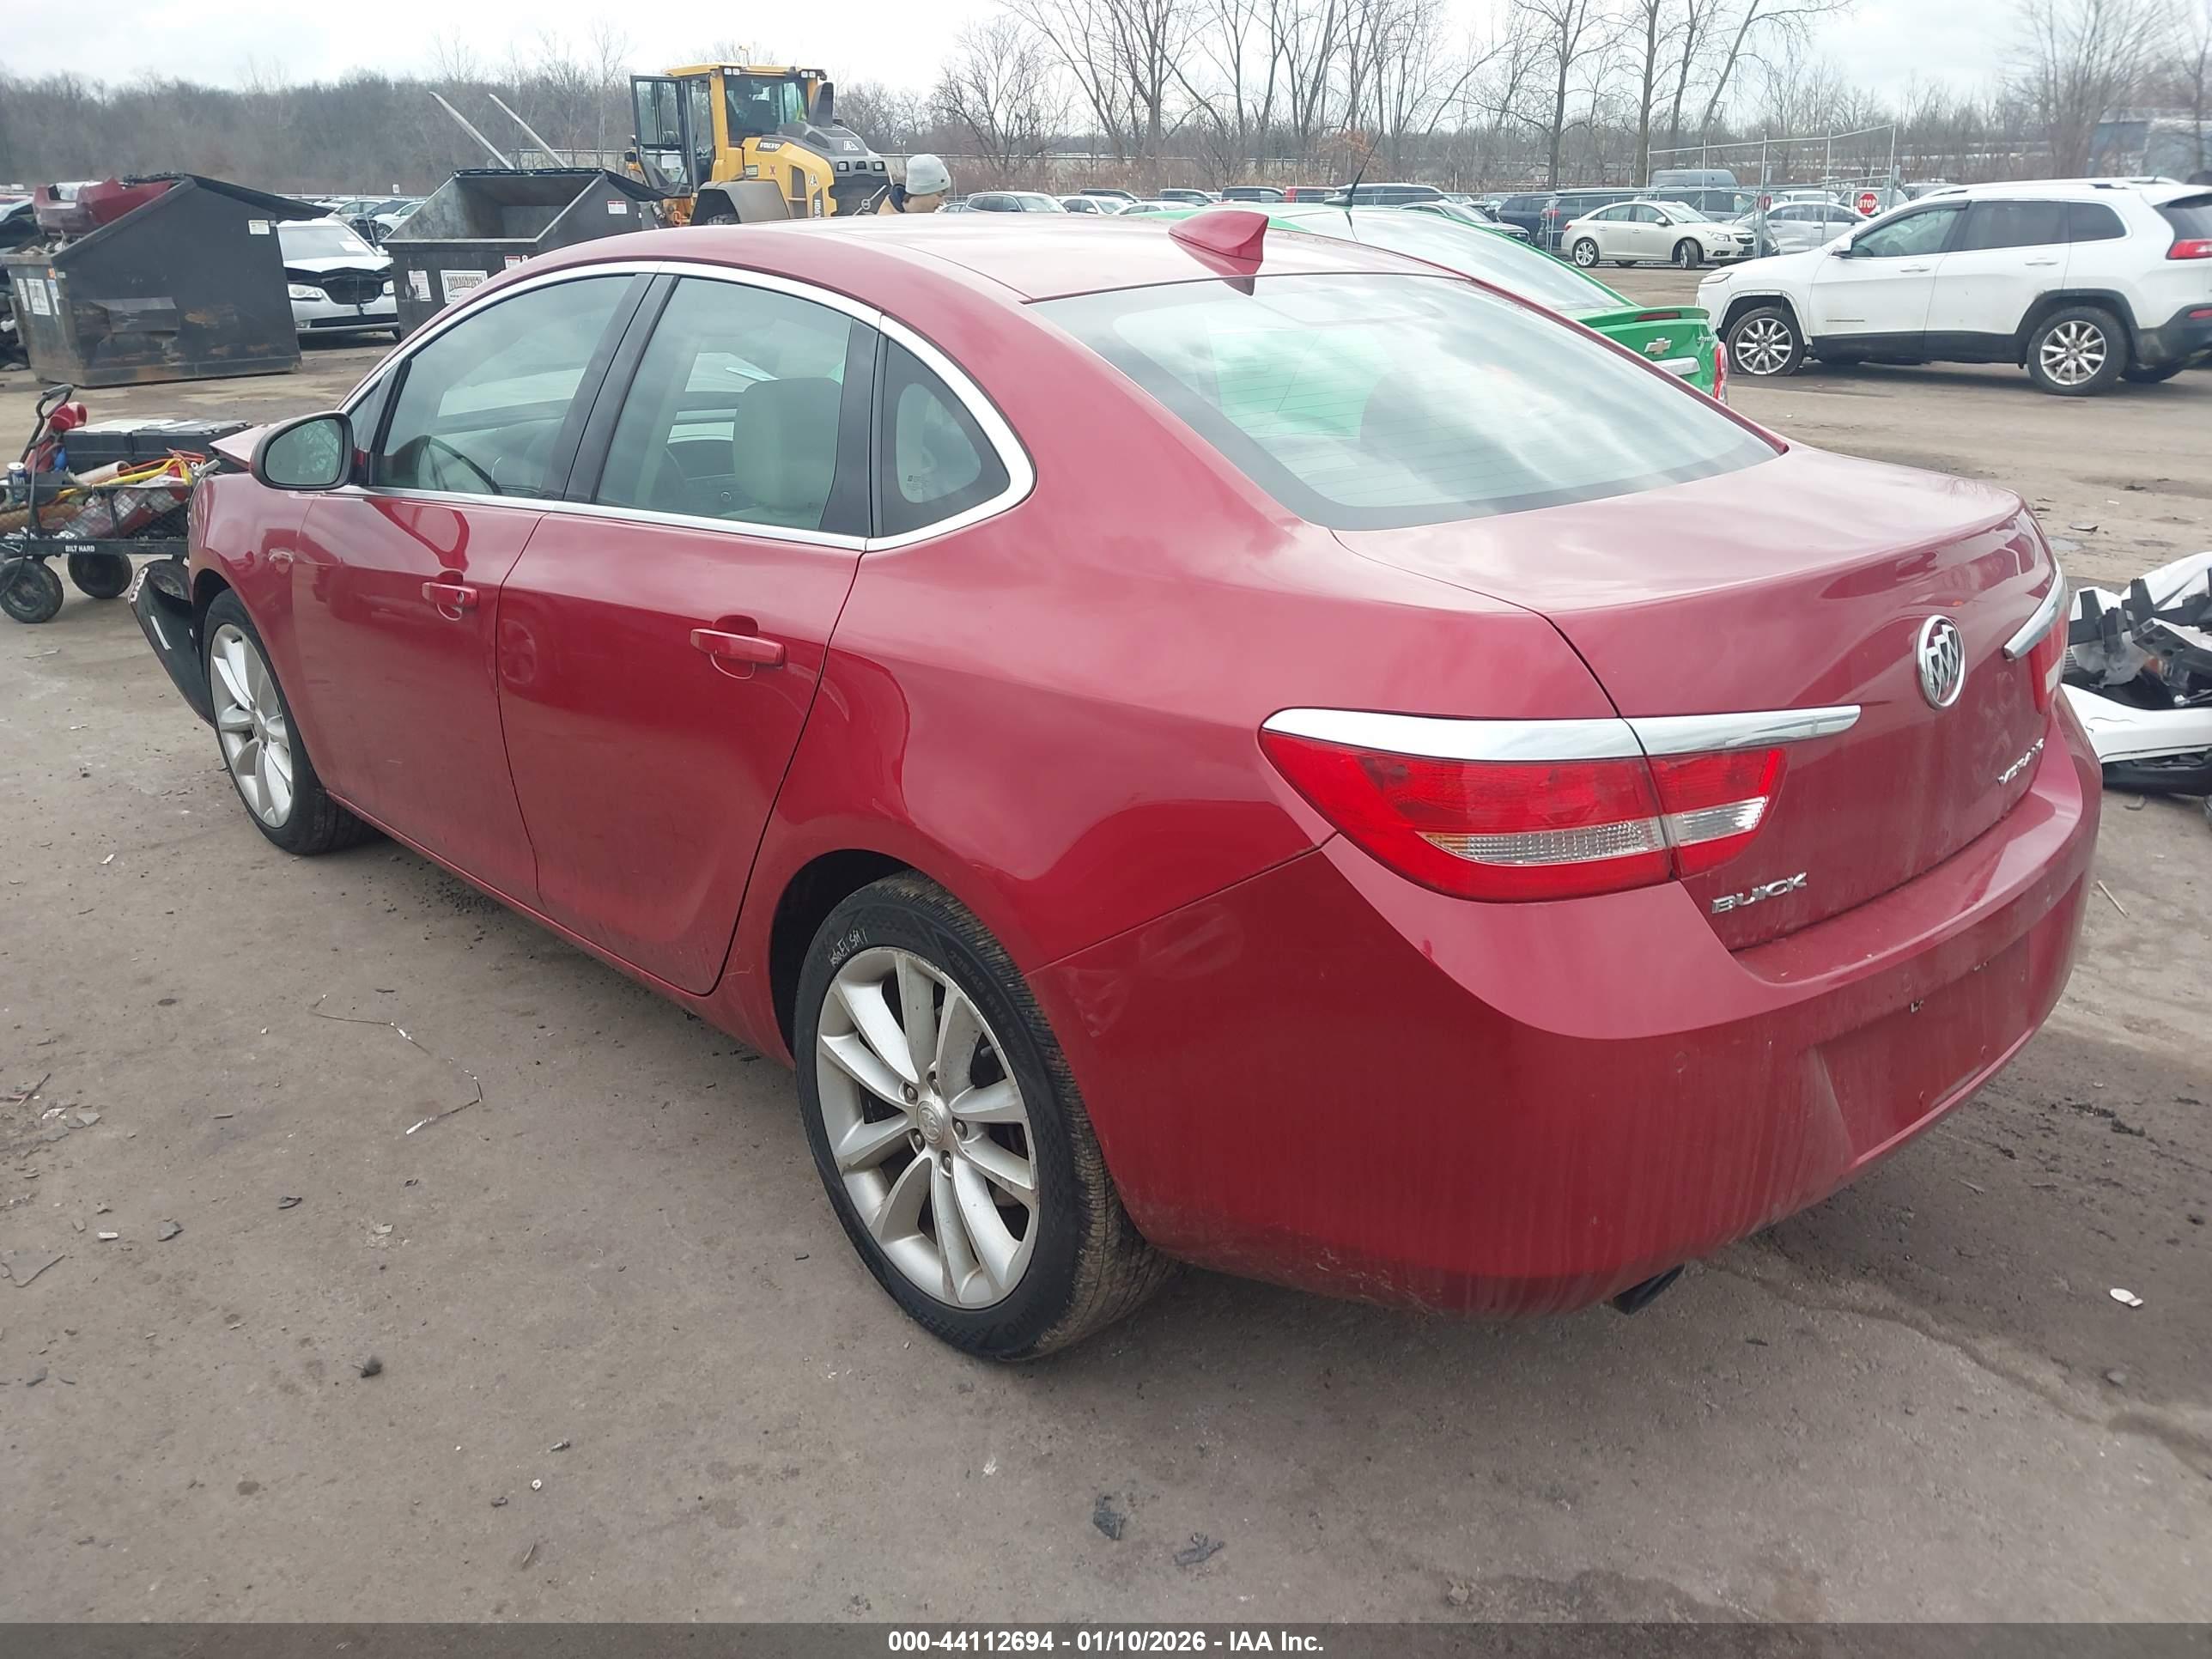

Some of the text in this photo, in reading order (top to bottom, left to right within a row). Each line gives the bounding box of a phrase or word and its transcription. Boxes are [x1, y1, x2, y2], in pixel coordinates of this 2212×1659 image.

[759, 142, 781, 150] VOLVO
[1858, 198, 1876, 209] STOP
[1711, 872, 1808, 914] BUICK
